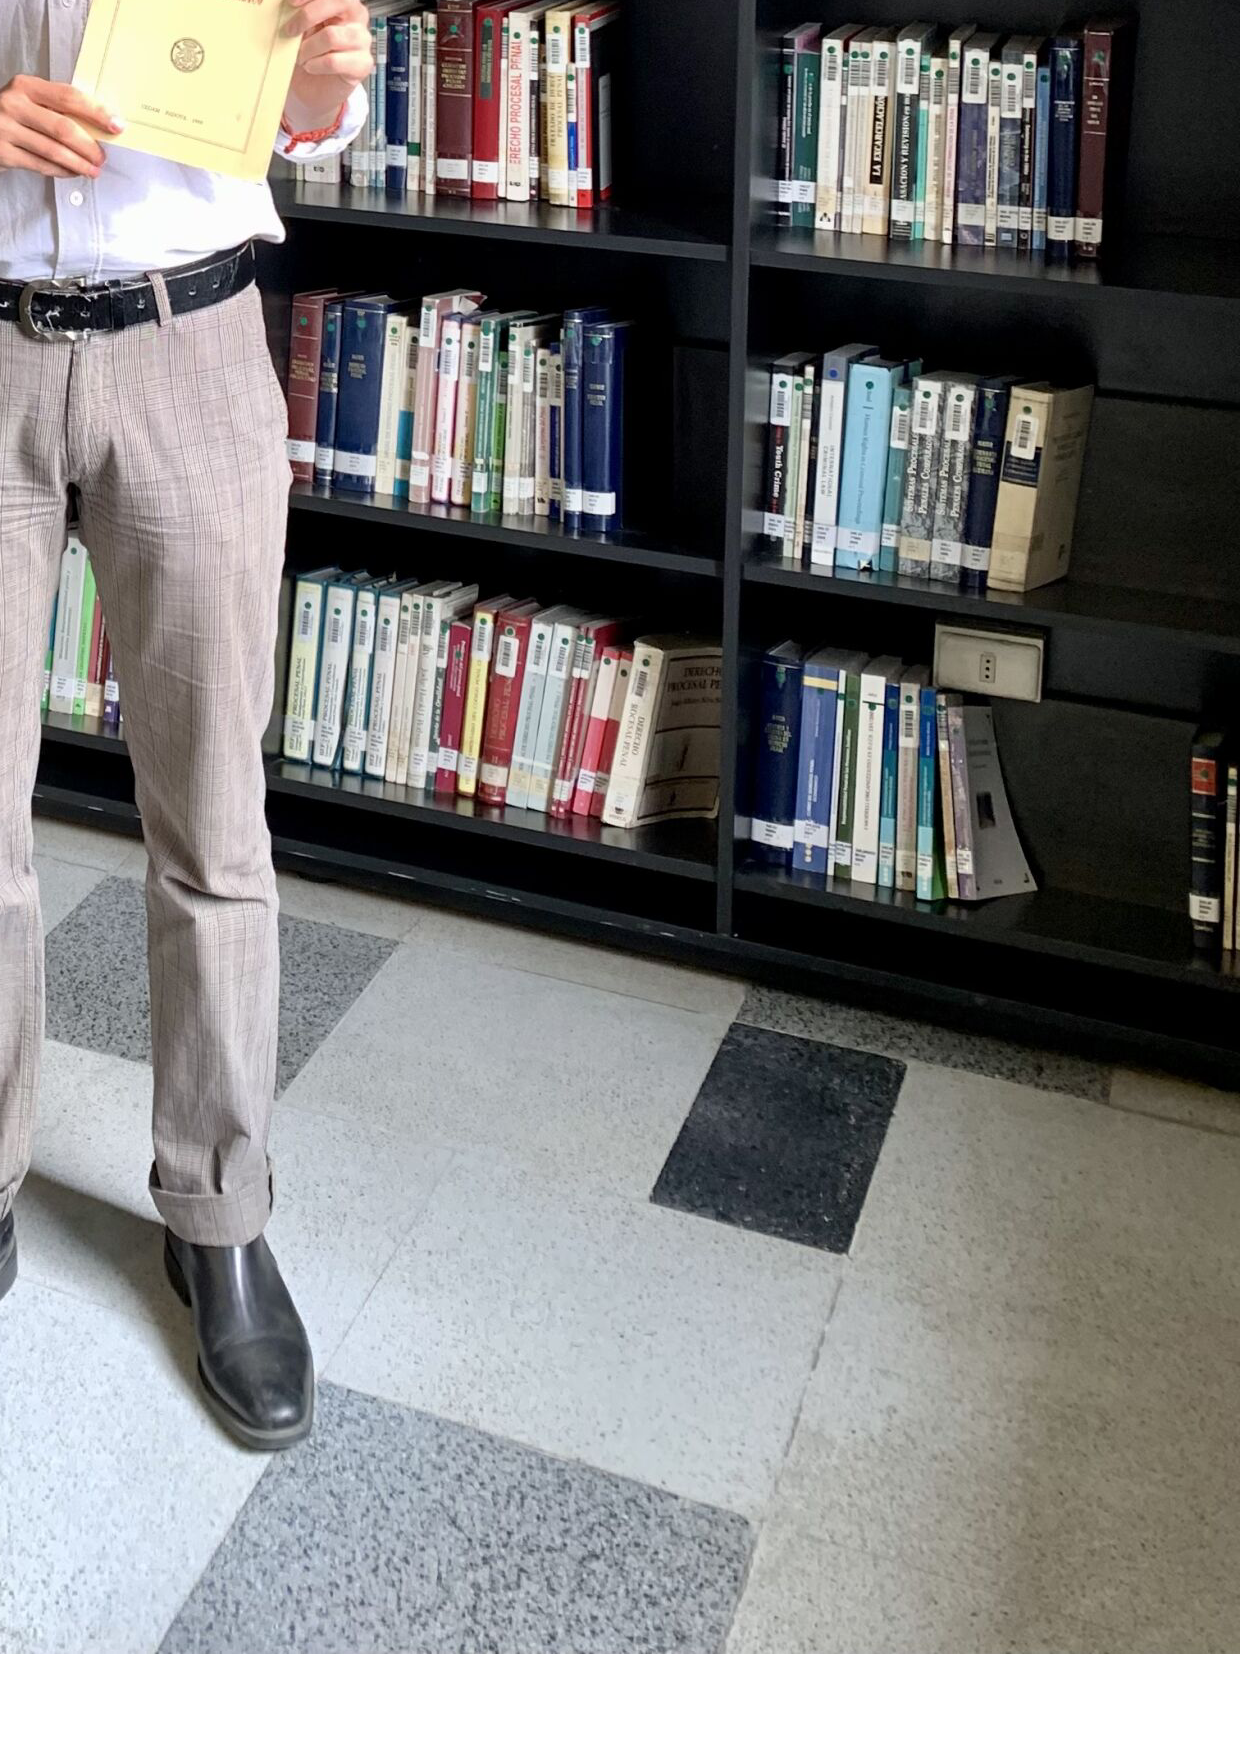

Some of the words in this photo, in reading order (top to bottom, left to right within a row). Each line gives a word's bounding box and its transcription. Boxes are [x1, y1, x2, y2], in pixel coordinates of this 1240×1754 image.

[510, 41, 523, 70] PENAL
[141, 104, 161, 113] CEDAM
[165, 110, 187, 120] PADOVA
[510, 74, 522, 123] PROCESAL
[873, 96, 886, 162] EXCARCELACIÓN
[900, 115, 910, 155] REVISION
[871, 164, 882, 176] LA
[899, 164, 909, 199] ASACION
[775, 445, 784, 469] Youth
[860, 437, 869, 455] Rights
[773, 470, 782, 498] Crime
[826, 445, 835, 497] INTERNATIONAL
[918, 483, 929, 514] PENALES
[937, 480, 948, 515] SISTEMAS
[951, 485, 962, 517] PENALES
[325, 663, 333, 685] PENAL
[375, 672, 383, 694] PENAL
[667, 678, 707, 693] PROCESAL
[292, 679, 301, 715] PROCESAL
[322, 685, 331, 722] PROCESAL
[348, 690, 358, 726] PROCESAL
[372, 695, 380, 731] PROCESAL
[490, 698, 500, 740] DERECHO
[499, 699, 510, 740] PROCESAL
[632, 716, 645, 755] DERECHO
[620, 743, 631, 767] PENAL
